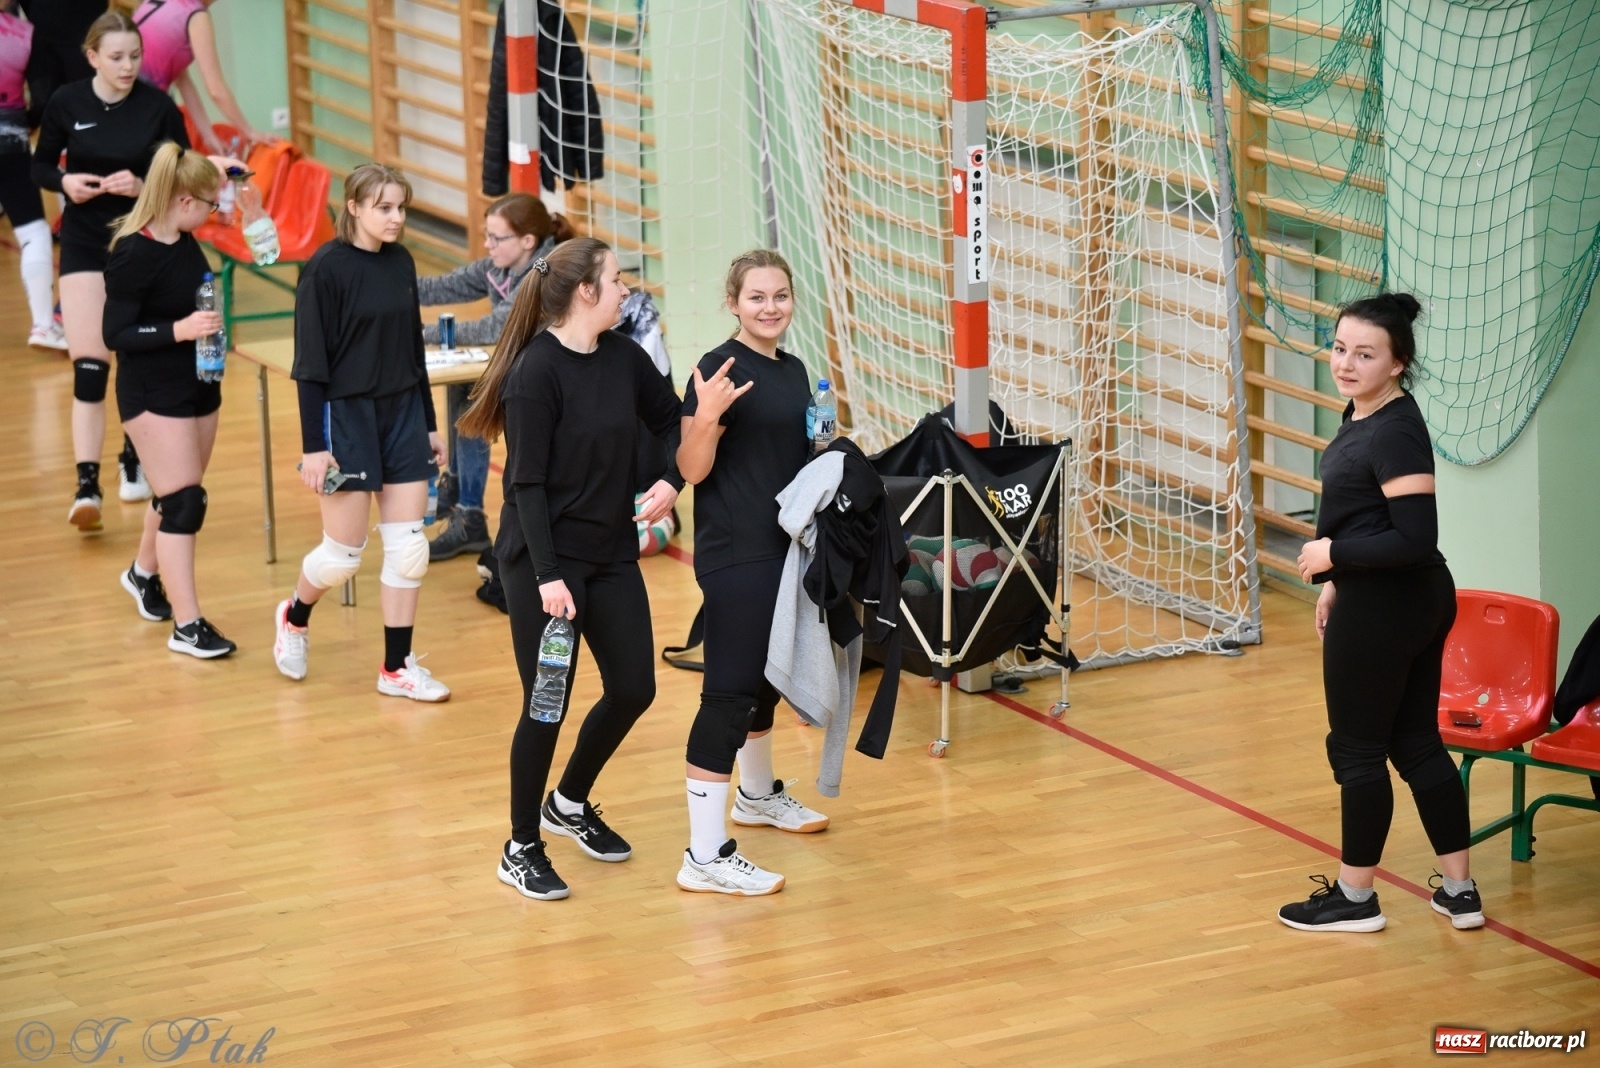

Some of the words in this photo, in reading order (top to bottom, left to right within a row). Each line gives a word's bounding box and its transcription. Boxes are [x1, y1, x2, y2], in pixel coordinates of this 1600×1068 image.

[973, 217, 982, 280] sport
[996, 483, 1028, 503] ZOO
[1003, 494, 1032, 513] MAR
